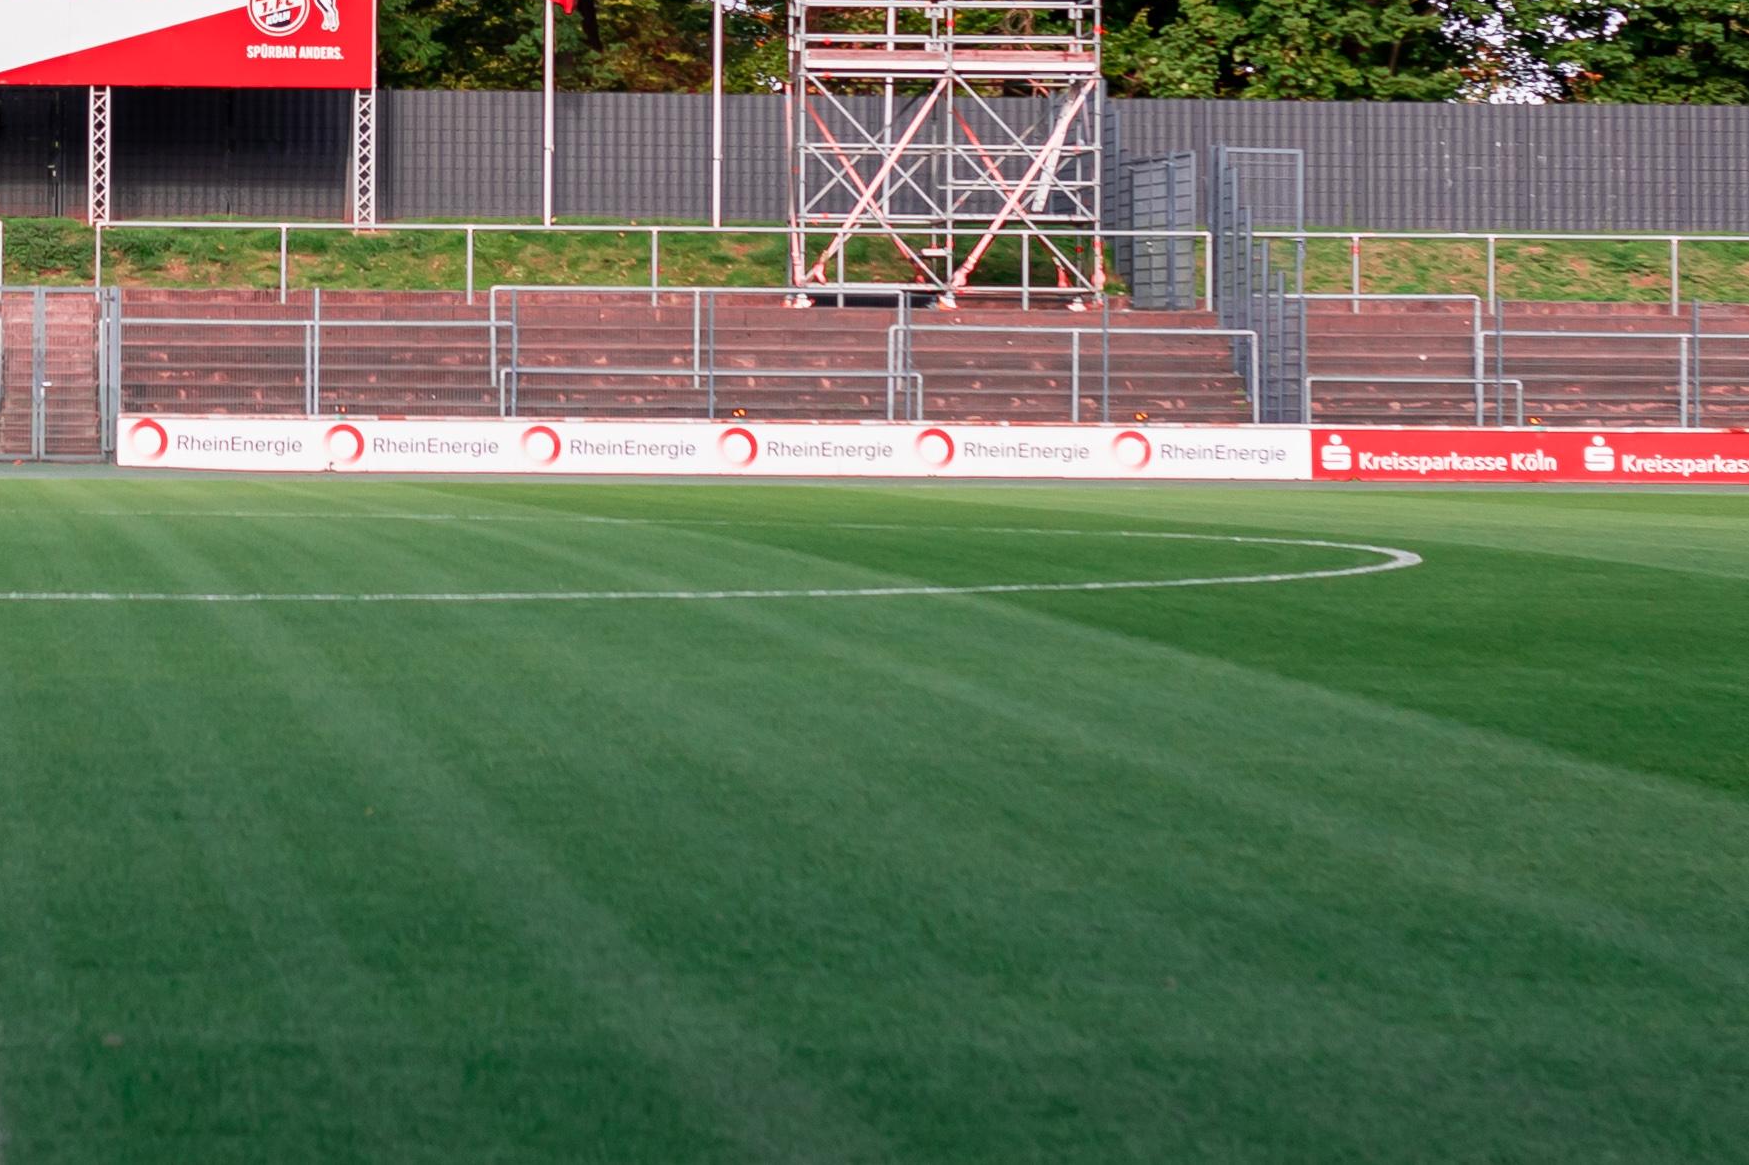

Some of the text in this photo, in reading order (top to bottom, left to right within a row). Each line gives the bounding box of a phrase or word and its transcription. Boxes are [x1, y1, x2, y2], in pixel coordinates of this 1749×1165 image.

[246, 43, 345, 60] SPÜRBAR ANDERS.
[176, 434, 303, 455] RheinEnergie
[372, 437, 500, 458] RheinEnergie
[569, 438, 697, 460] RheinEnergie
[766, 440, 894, 461] RheinEnergie
[963, 441, 1091, 463] RheinEnergie
[1160, 443, 1287, 465] RheinEnergie
[1358, 449, 1558, 475] Kreissparkasse Köln
[1621, 453, 1749, 477] Kreissparkas
